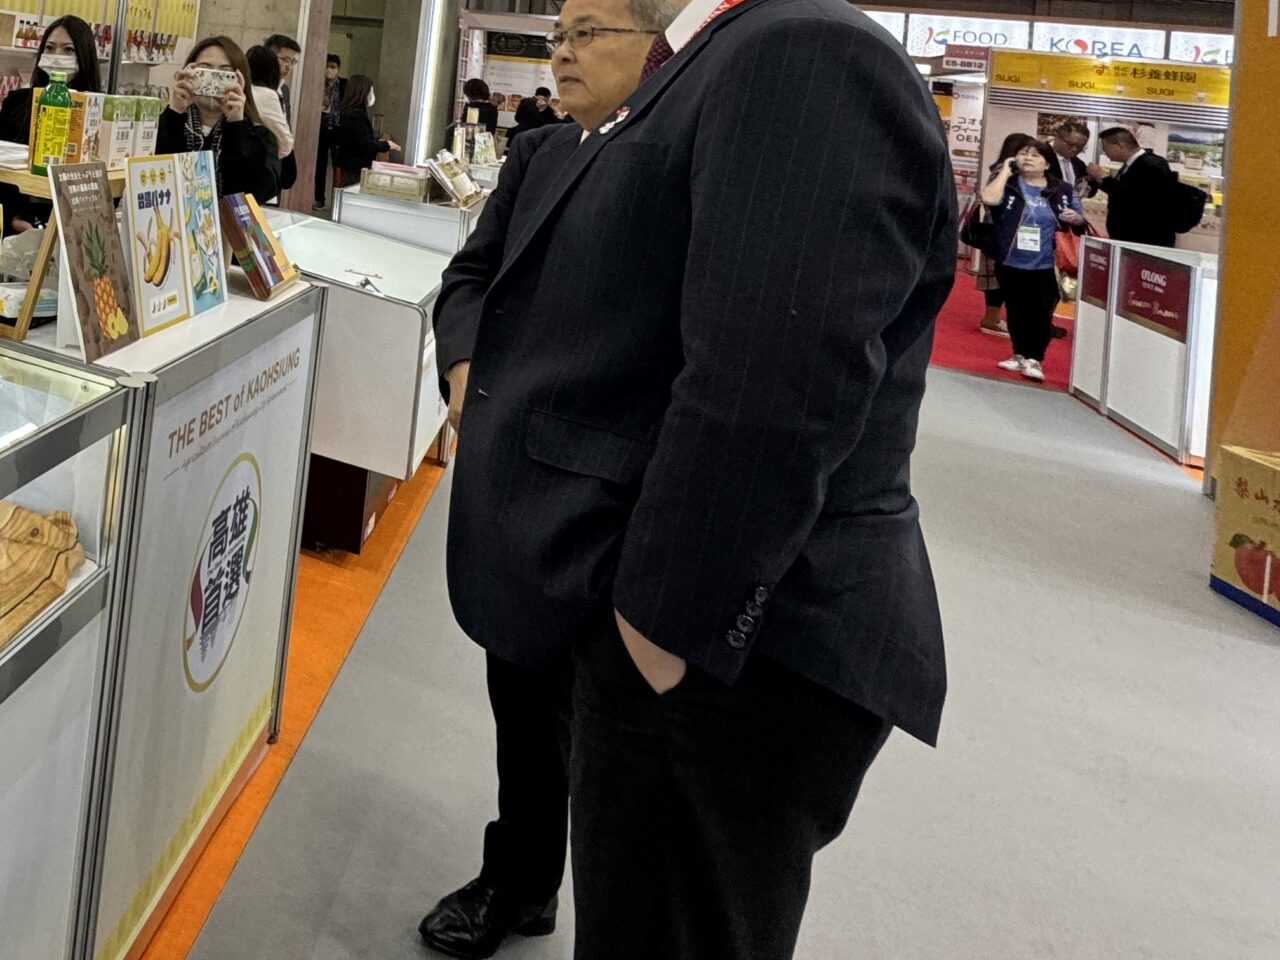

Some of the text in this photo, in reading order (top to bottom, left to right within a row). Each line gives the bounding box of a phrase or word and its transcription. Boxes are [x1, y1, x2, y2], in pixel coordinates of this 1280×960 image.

[953, 30, 1008, 46] FOOD
[1049, 37, 1144, 58] KOREA
[995, 73, 1020, 83] SUGI
[1131, 67, 1197, 84] 杉養蜂園
[1068, 80, 1095, 90] SUGI
[1146, 86, 1175, 97] SUGI
[168, 417, 197, 458] THE
[199, 394, 232, 438] BEST
[233, 384, 245, 412] of
[246, 347, 301, 403] KAOHSIUNG
[208, 485, 251, 569] 高雄
[201, 544, 244, 635] 首選
